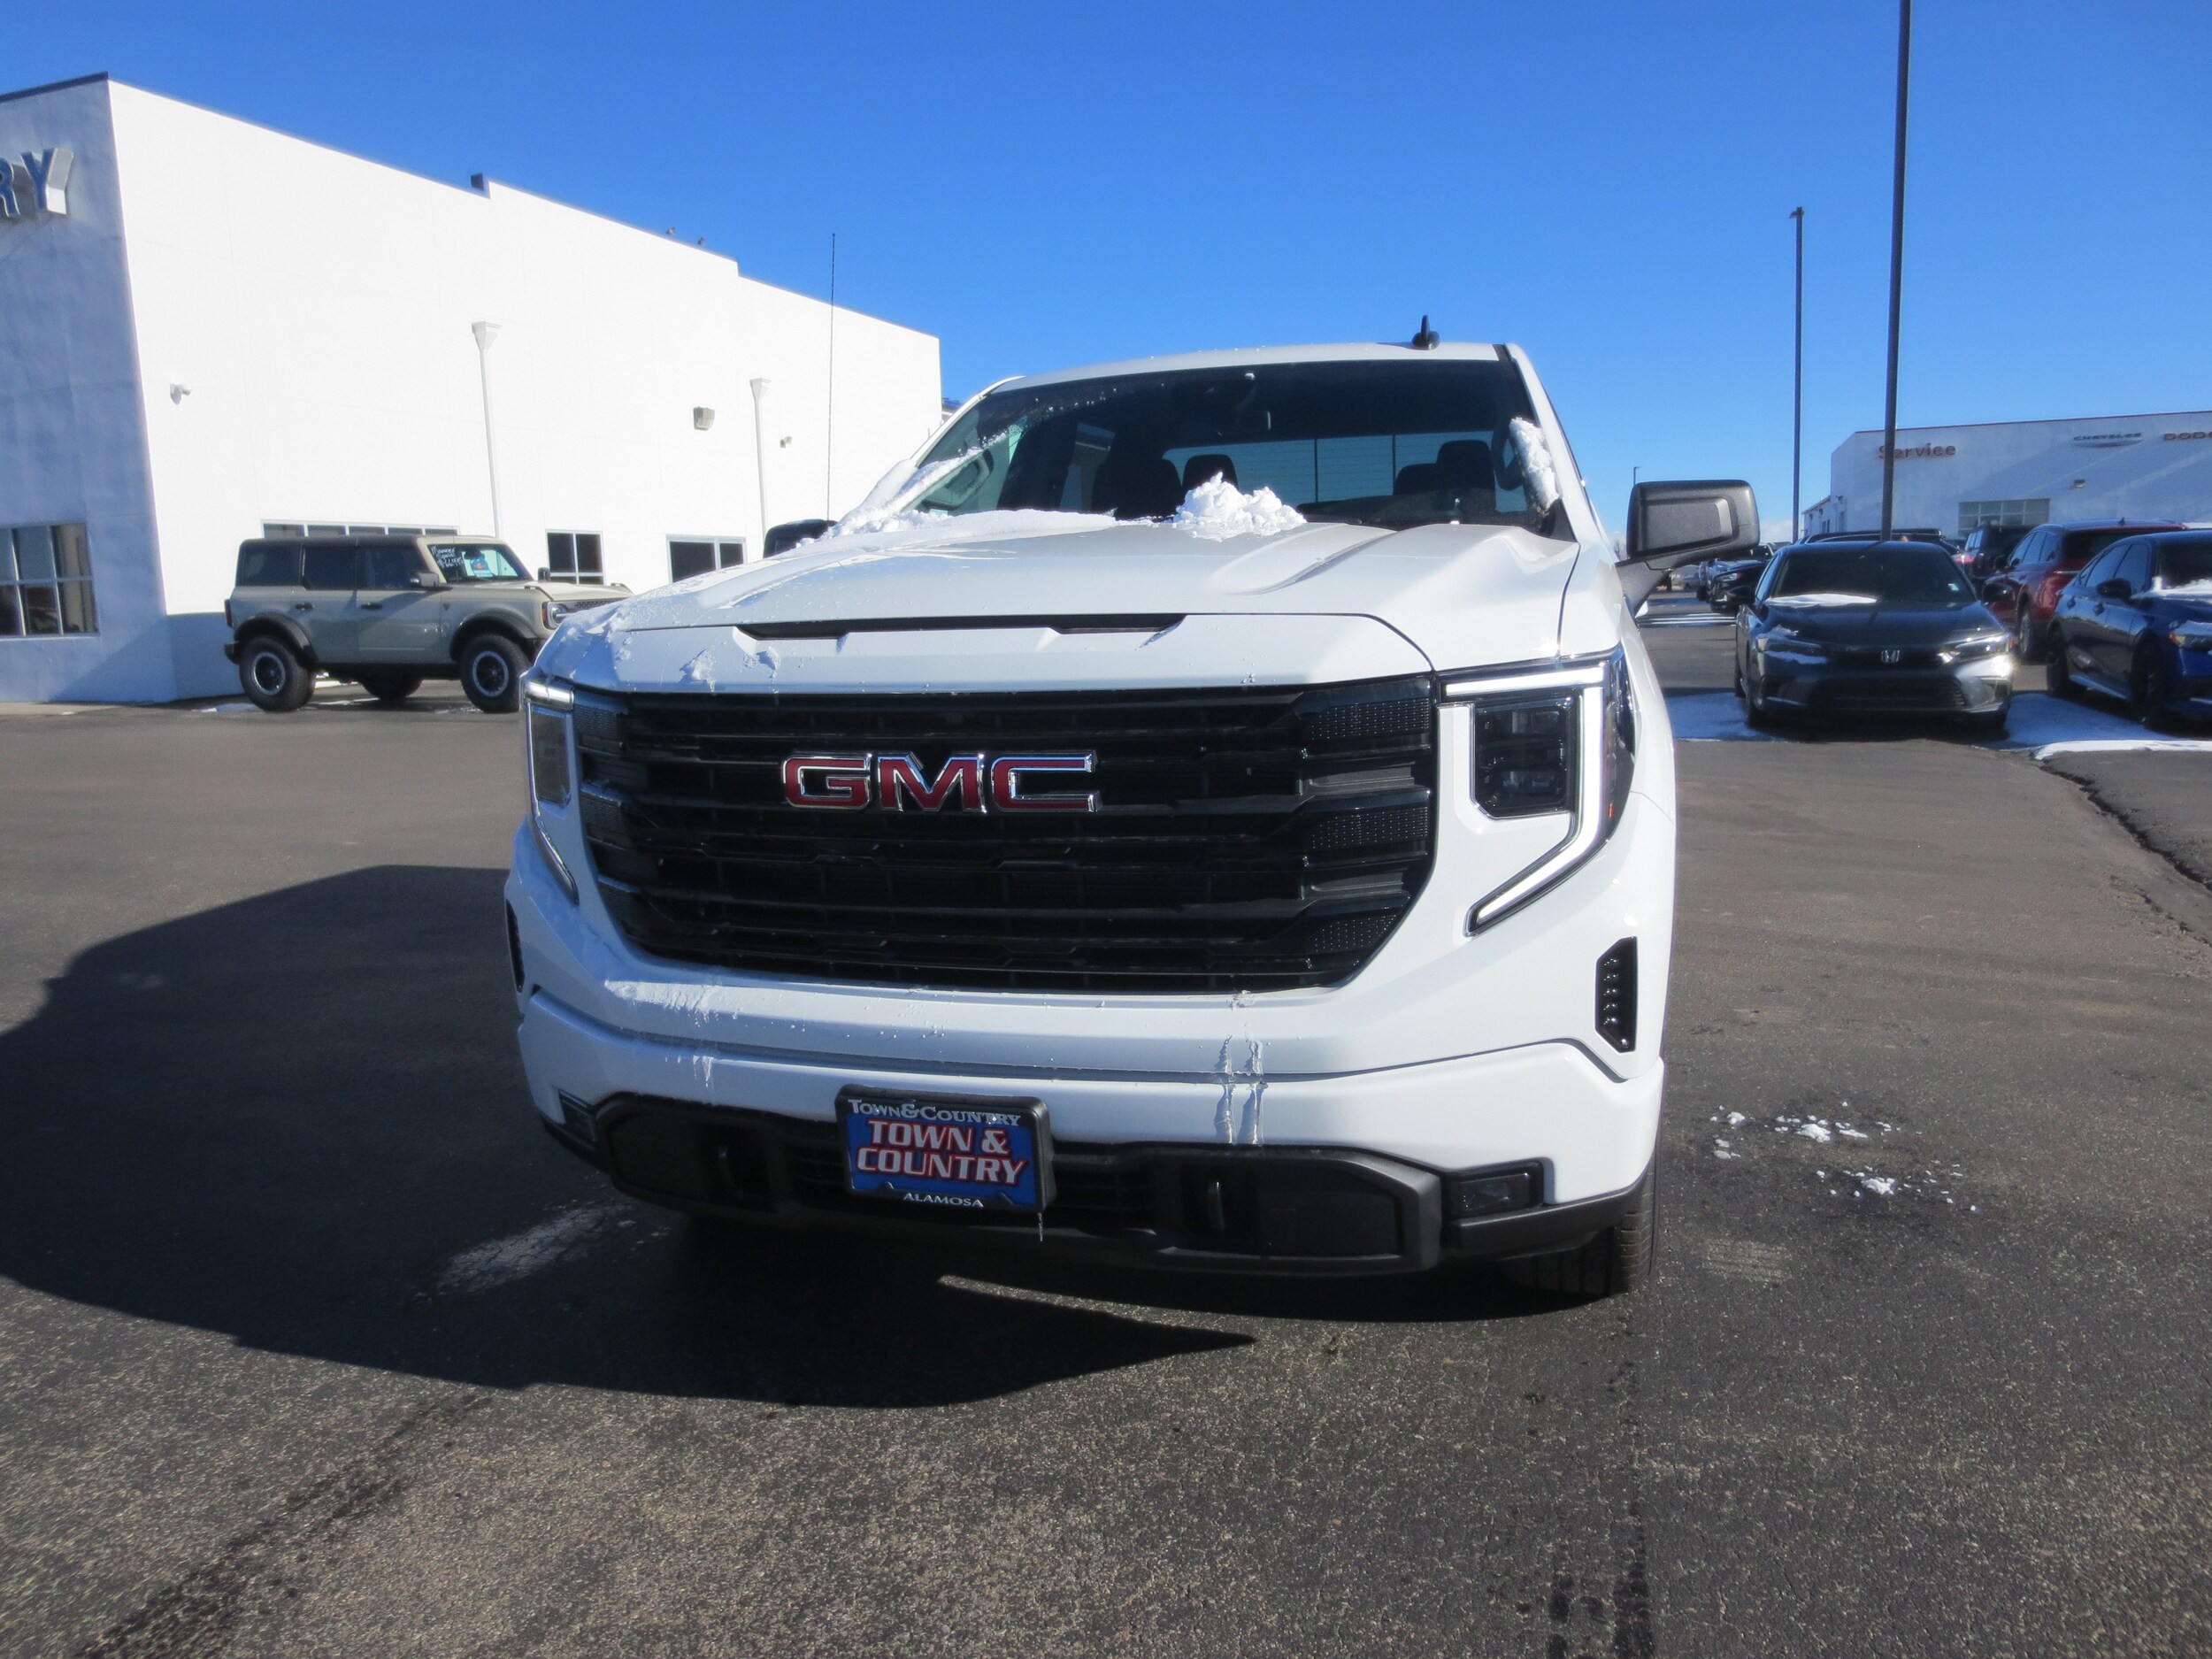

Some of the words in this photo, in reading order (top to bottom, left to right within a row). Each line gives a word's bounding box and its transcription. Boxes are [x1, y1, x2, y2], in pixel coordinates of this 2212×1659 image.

[782, 751, 1099, 813] GMC
[867, 1119, 973, 1153] TOWN
[981, 1128, 1010, 1156] &
[856, 1147, 1027, 1187] COUNTRY
[902, 1192, 985, 1209] ALAMOSA
